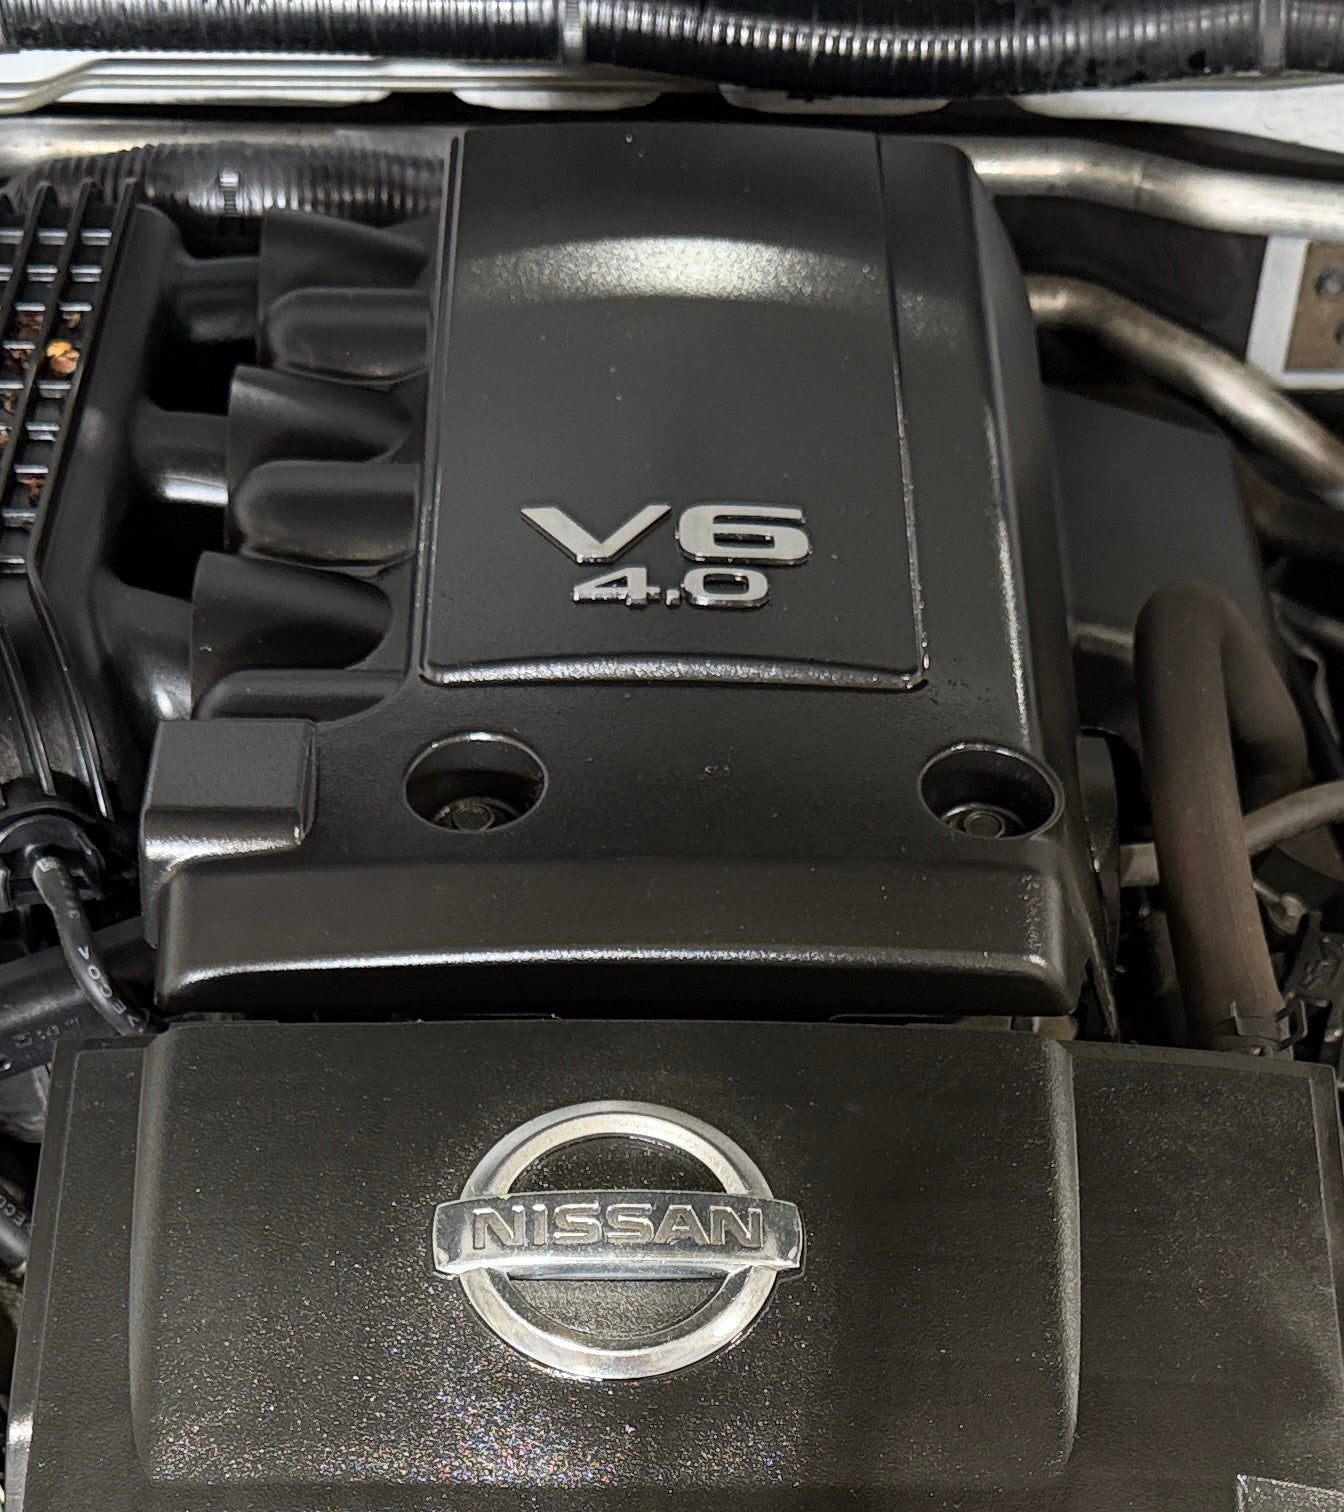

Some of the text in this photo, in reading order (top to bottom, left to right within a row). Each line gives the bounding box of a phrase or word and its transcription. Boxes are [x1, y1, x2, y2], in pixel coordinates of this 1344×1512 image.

[521, 503, 811, 566] V6
[572, 566, 769, 608] 4.0
[472, 1203, 763, 1249] NISSAN
